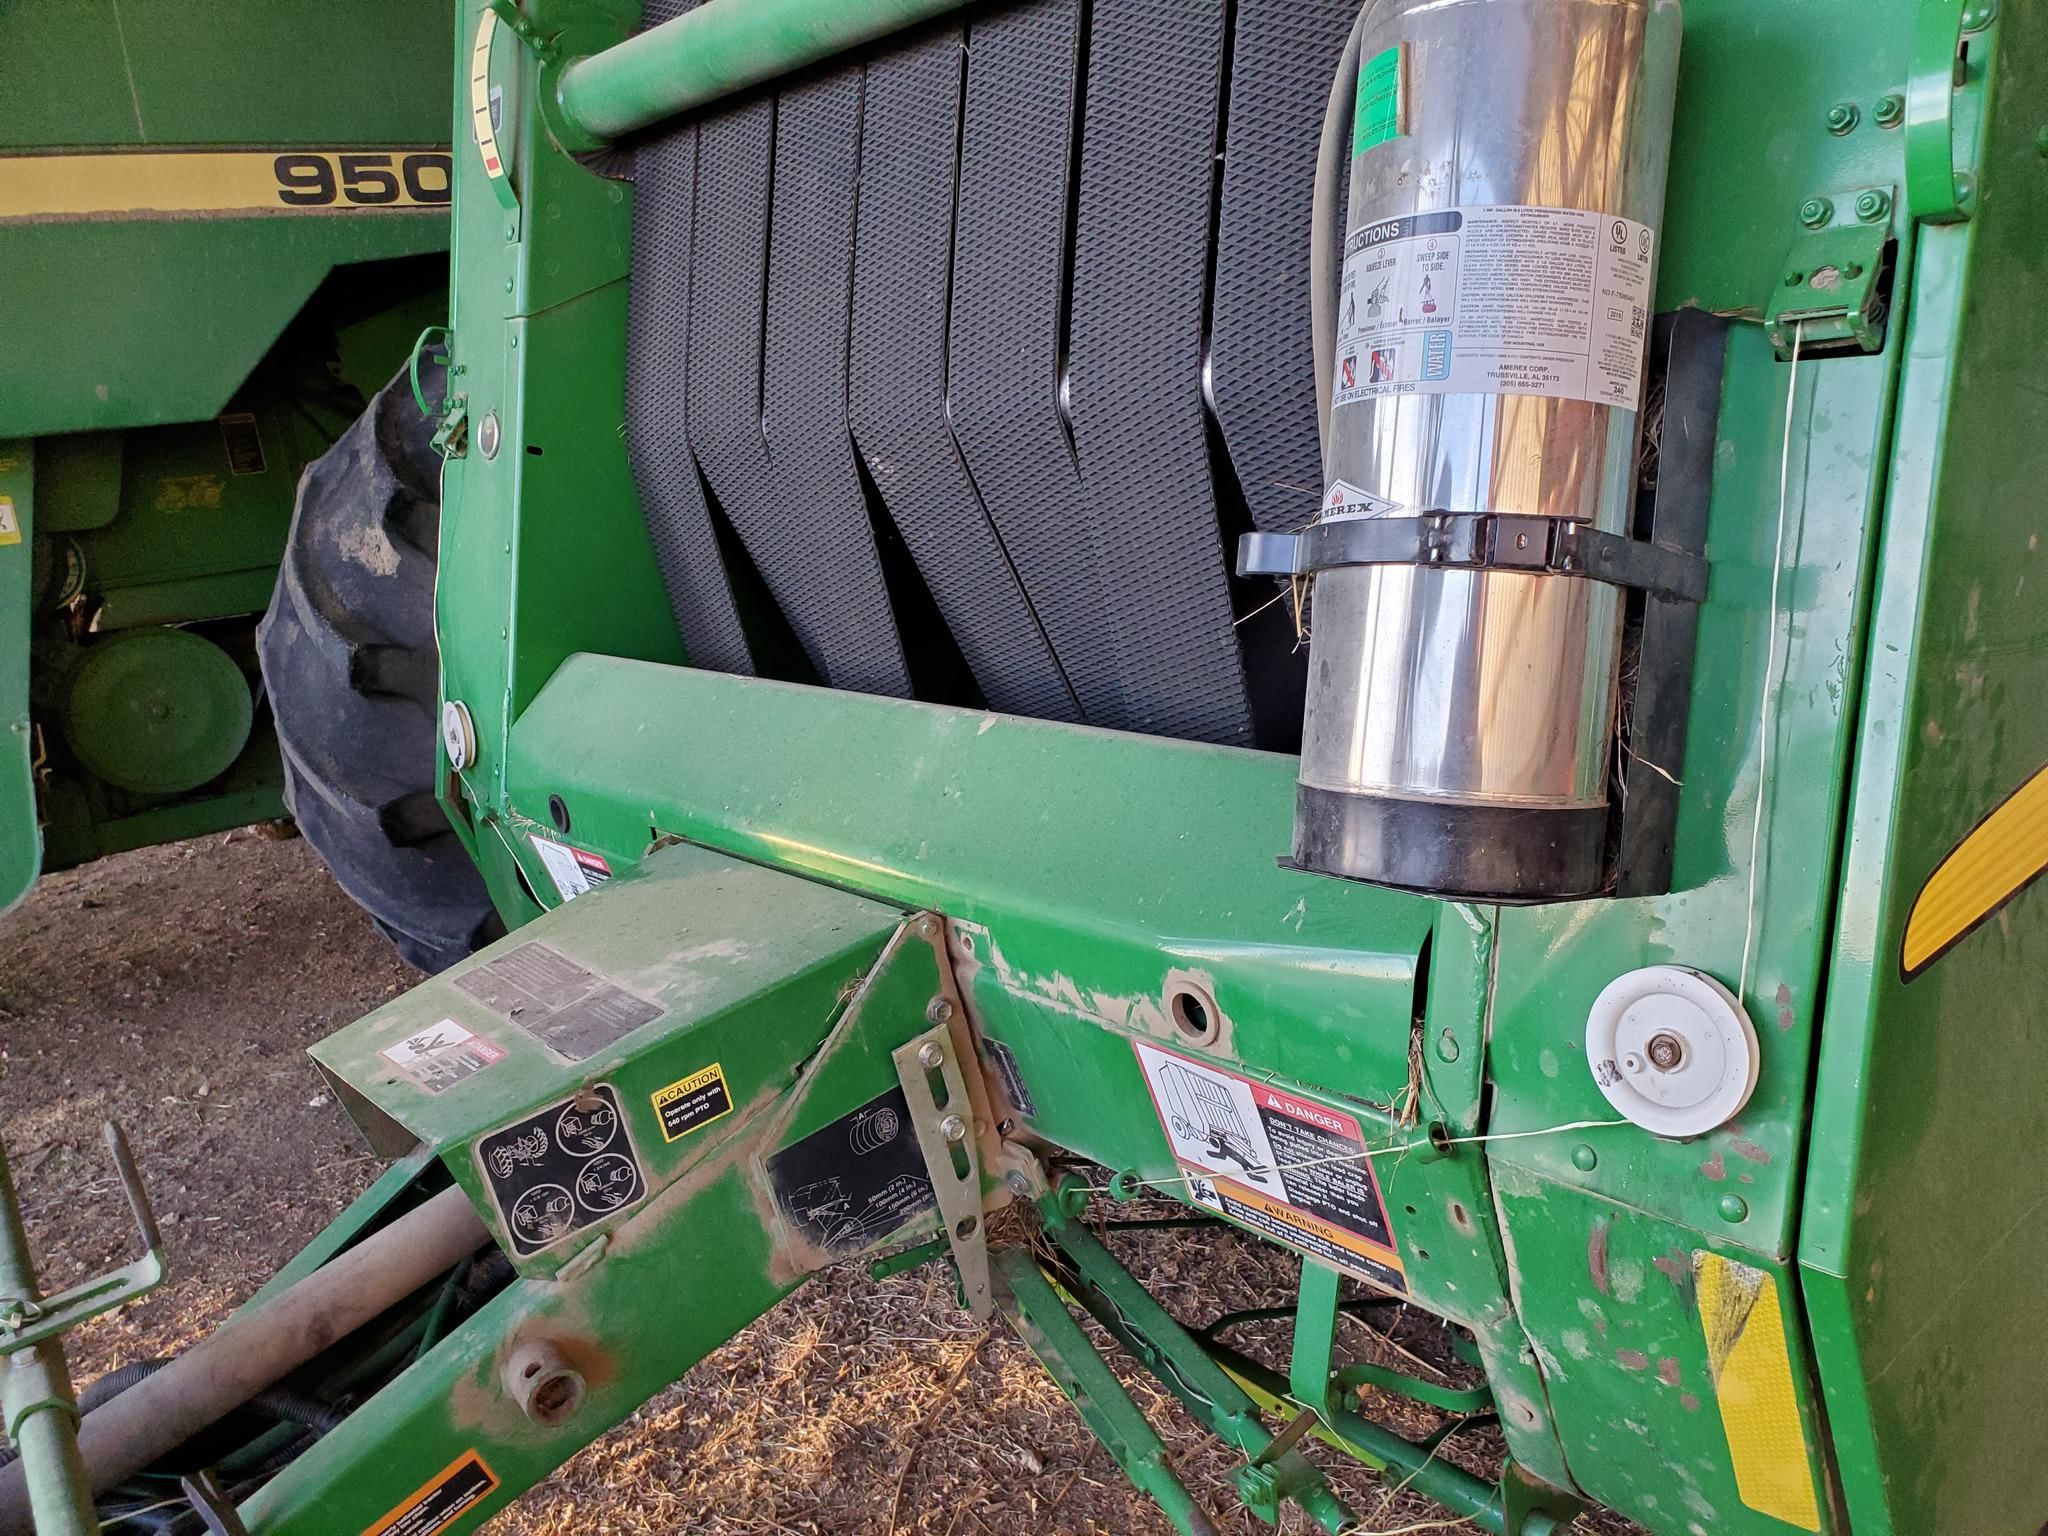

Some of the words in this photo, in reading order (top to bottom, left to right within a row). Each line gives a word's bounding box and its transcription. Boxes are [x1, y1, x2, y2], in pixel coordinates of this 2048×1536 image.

[274, 154, 453, 205] 950
[1416, 252, 1435, 262] SWEEP
[1436, 251, 1450, 260] SIDE
[1422, 263, 1429, 272] TO
[1430, 262, 1445, 271] SIDE.
[1427, 333, 1447, 377] WATER
[1487, 371, 1530, 380] TRUSSVILLE,
[1529, 365, 1550, 373] CORP.
[1393, 383, 1416, 393] FIRES
[1613, 386, 1624, 395] 240
[668, 1069, 718, 1100] CAUTION
[664, 1102, 691, 1118] Operate
[692, 1094, 706, 1105] only
[706, 1086, 721, 1098] with
[680, 1111, 694, 1121] rpm
[694, 1102, 710, 1114] PTO
[1284, 1102, 1344, 1133] DANGER
[1267, 1125, 1275, 1133] To
[1276, 1129, 1295, 1141] avoid
[1268, 1116, 1293, 1130] DON'T
[1293, 1125, 1315, 1139] TAKE
[1272, 1140, 1282, 1149] Do
[1329, 1162, 1345, 1174] feed
[1346, 1170, 1363, 1181] crop
[843, 1203, 850, 1211] A
[875, 1193, 899, 1208] 100mm
[1321, 1199, 1337, 1210] PTO
[1337, 1206, 1351, 1216] and
[1345, 1197, 1359, 1208] you
[1272, 1207, 1334, 1239] WARNING
[1332, 1244, 1345, 1253] and
